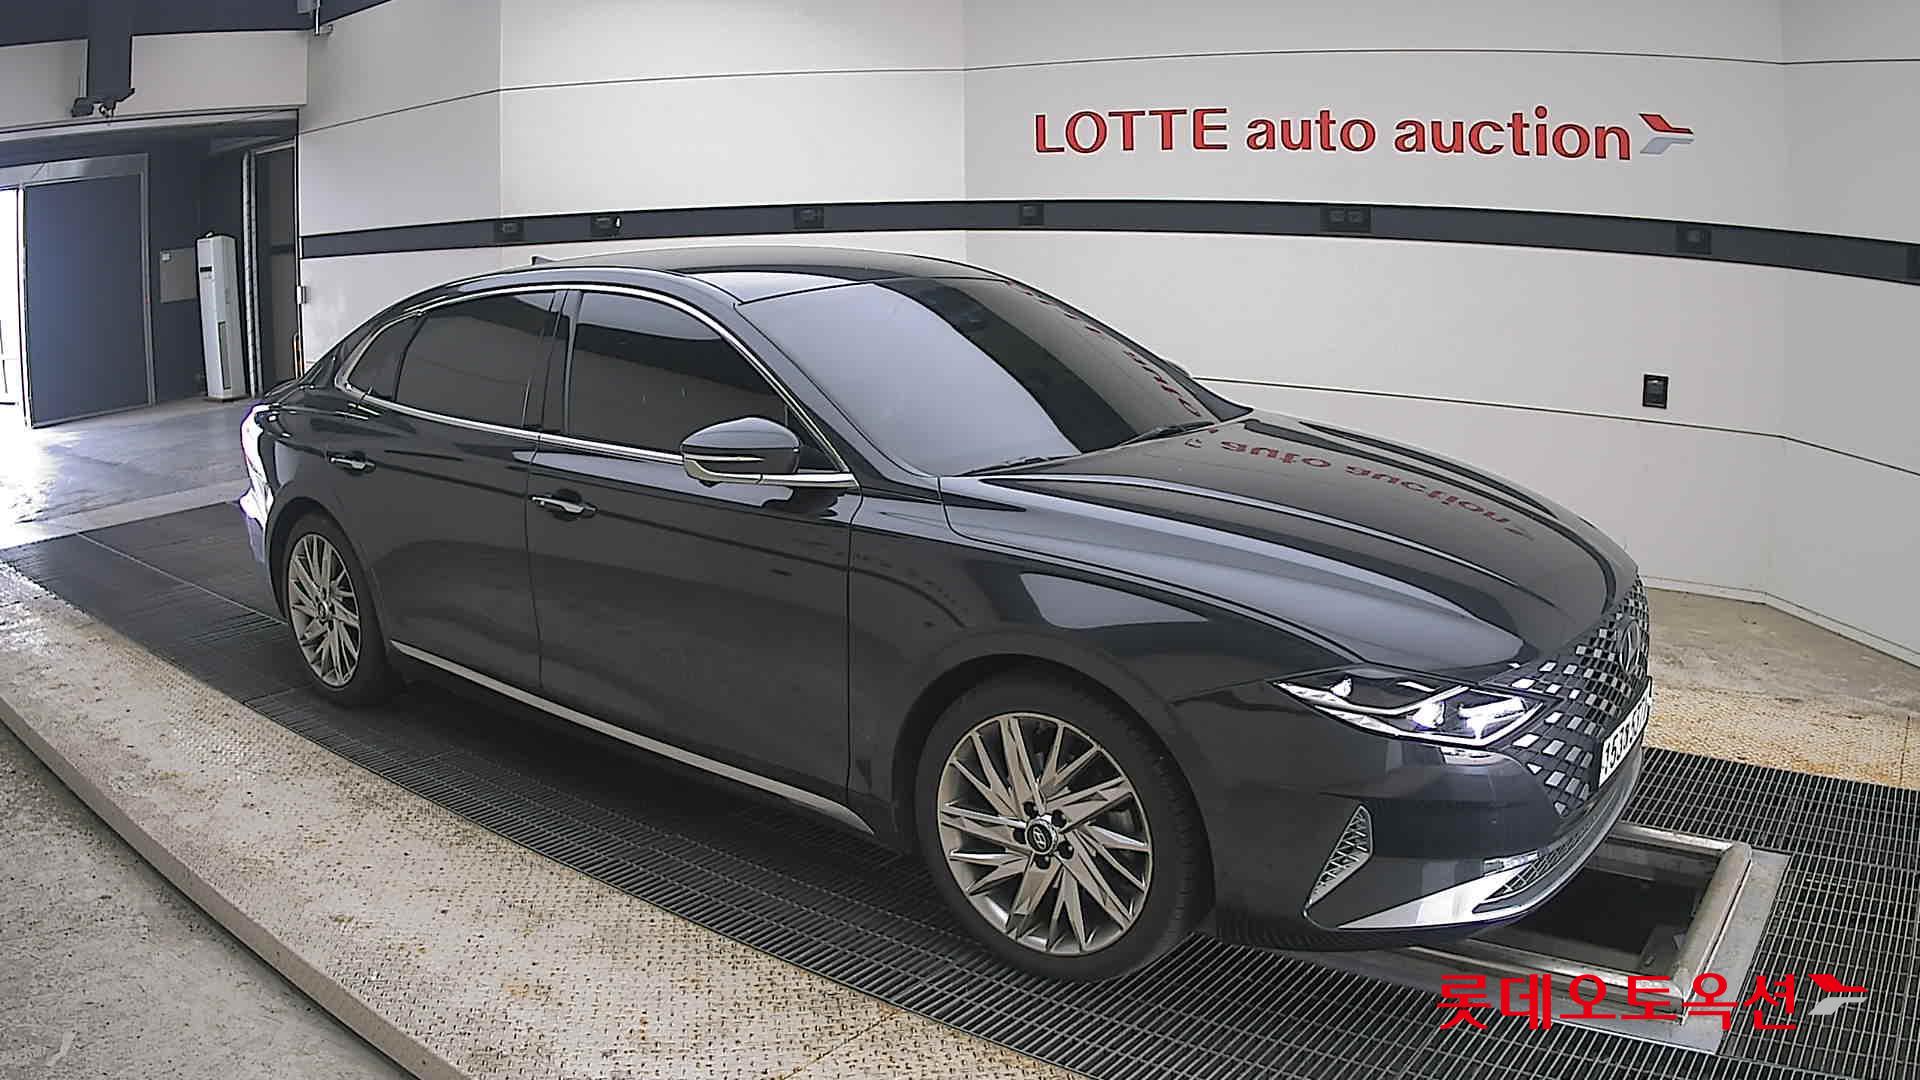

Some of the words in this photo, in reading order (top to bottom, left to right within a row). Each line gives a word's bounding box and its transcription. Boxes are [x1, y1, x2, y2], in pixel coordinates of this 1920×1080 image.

[1035, 107, 1228, 153] LOTTE
[1246, 109, 1376, 152] auto
[1393, 105, 1632, 160] auction
